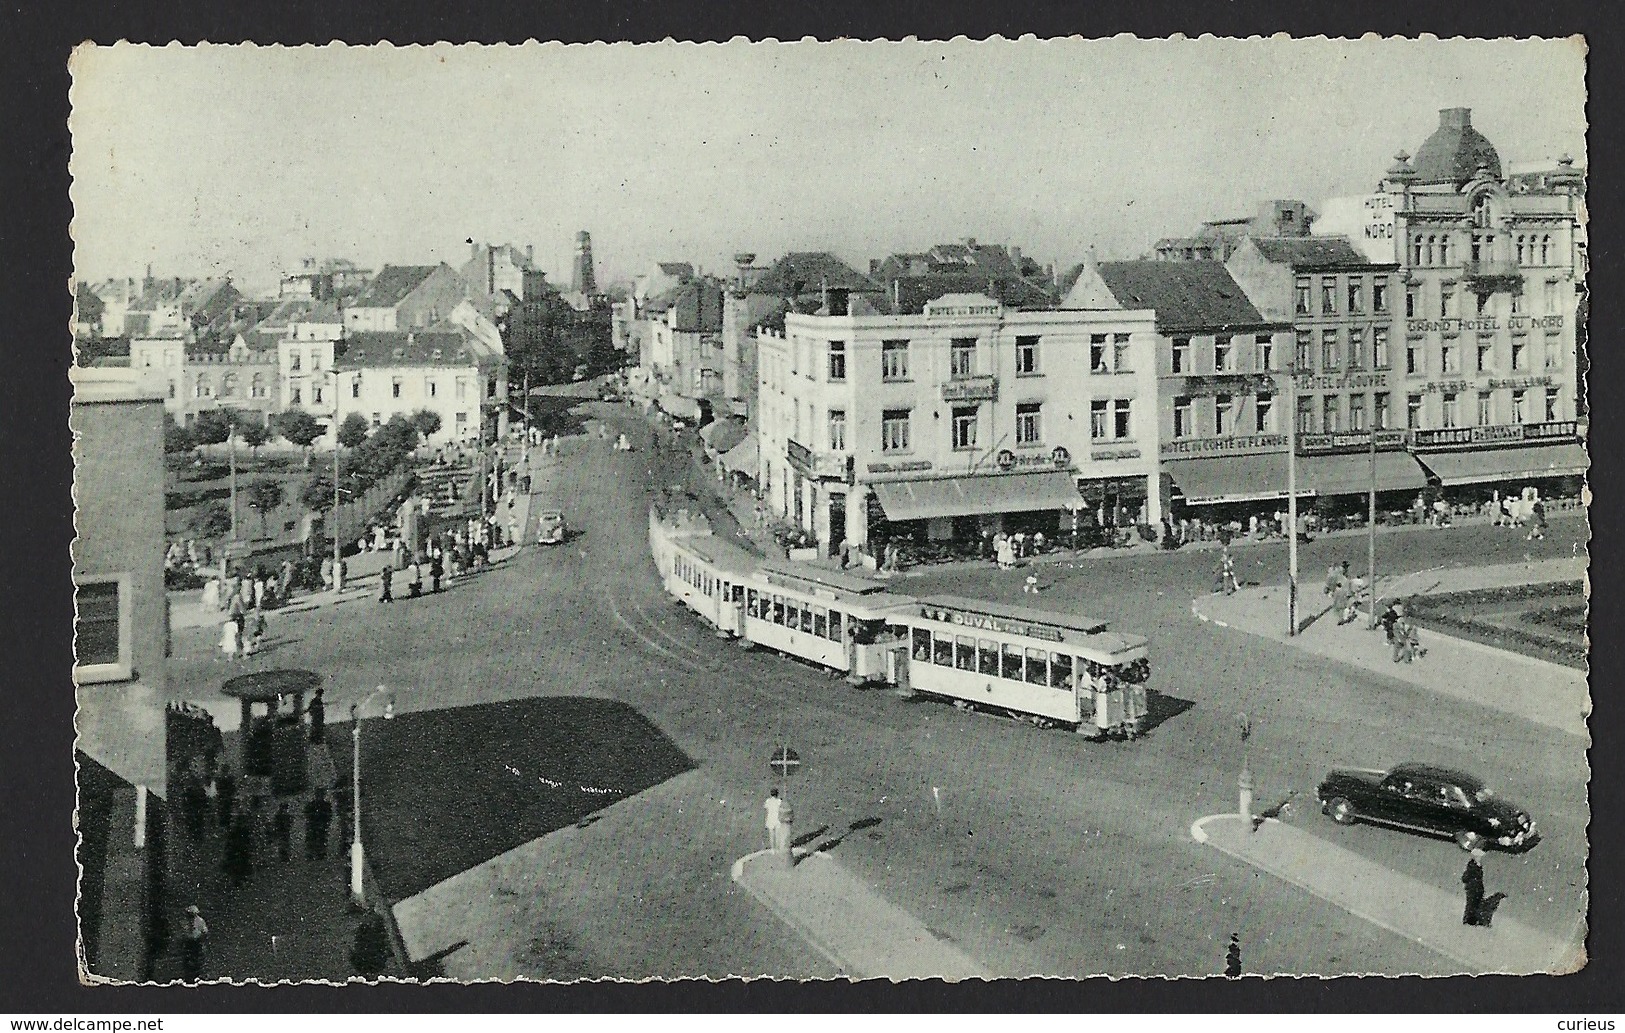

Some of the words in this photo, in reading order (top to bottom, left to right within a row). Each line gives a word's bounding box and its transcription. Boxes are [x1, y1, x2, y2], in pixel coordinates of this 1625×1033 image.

[1365, 223, 1393, 239] NORD
[968, 305, 999, 315] BUFFET
[1407, 321, 1451, 333] GRAND
[1458, 319, 1501, 331] HOTEL
[1508, 317, 1524, 330] DU
[1531, 316, 1564, 329] NORD
[1160, 441, 1190, 454] HOTEL
[1248, 436, 1289, 449] FLANDRE
[953, 613, 1002, 632] DUVAL
